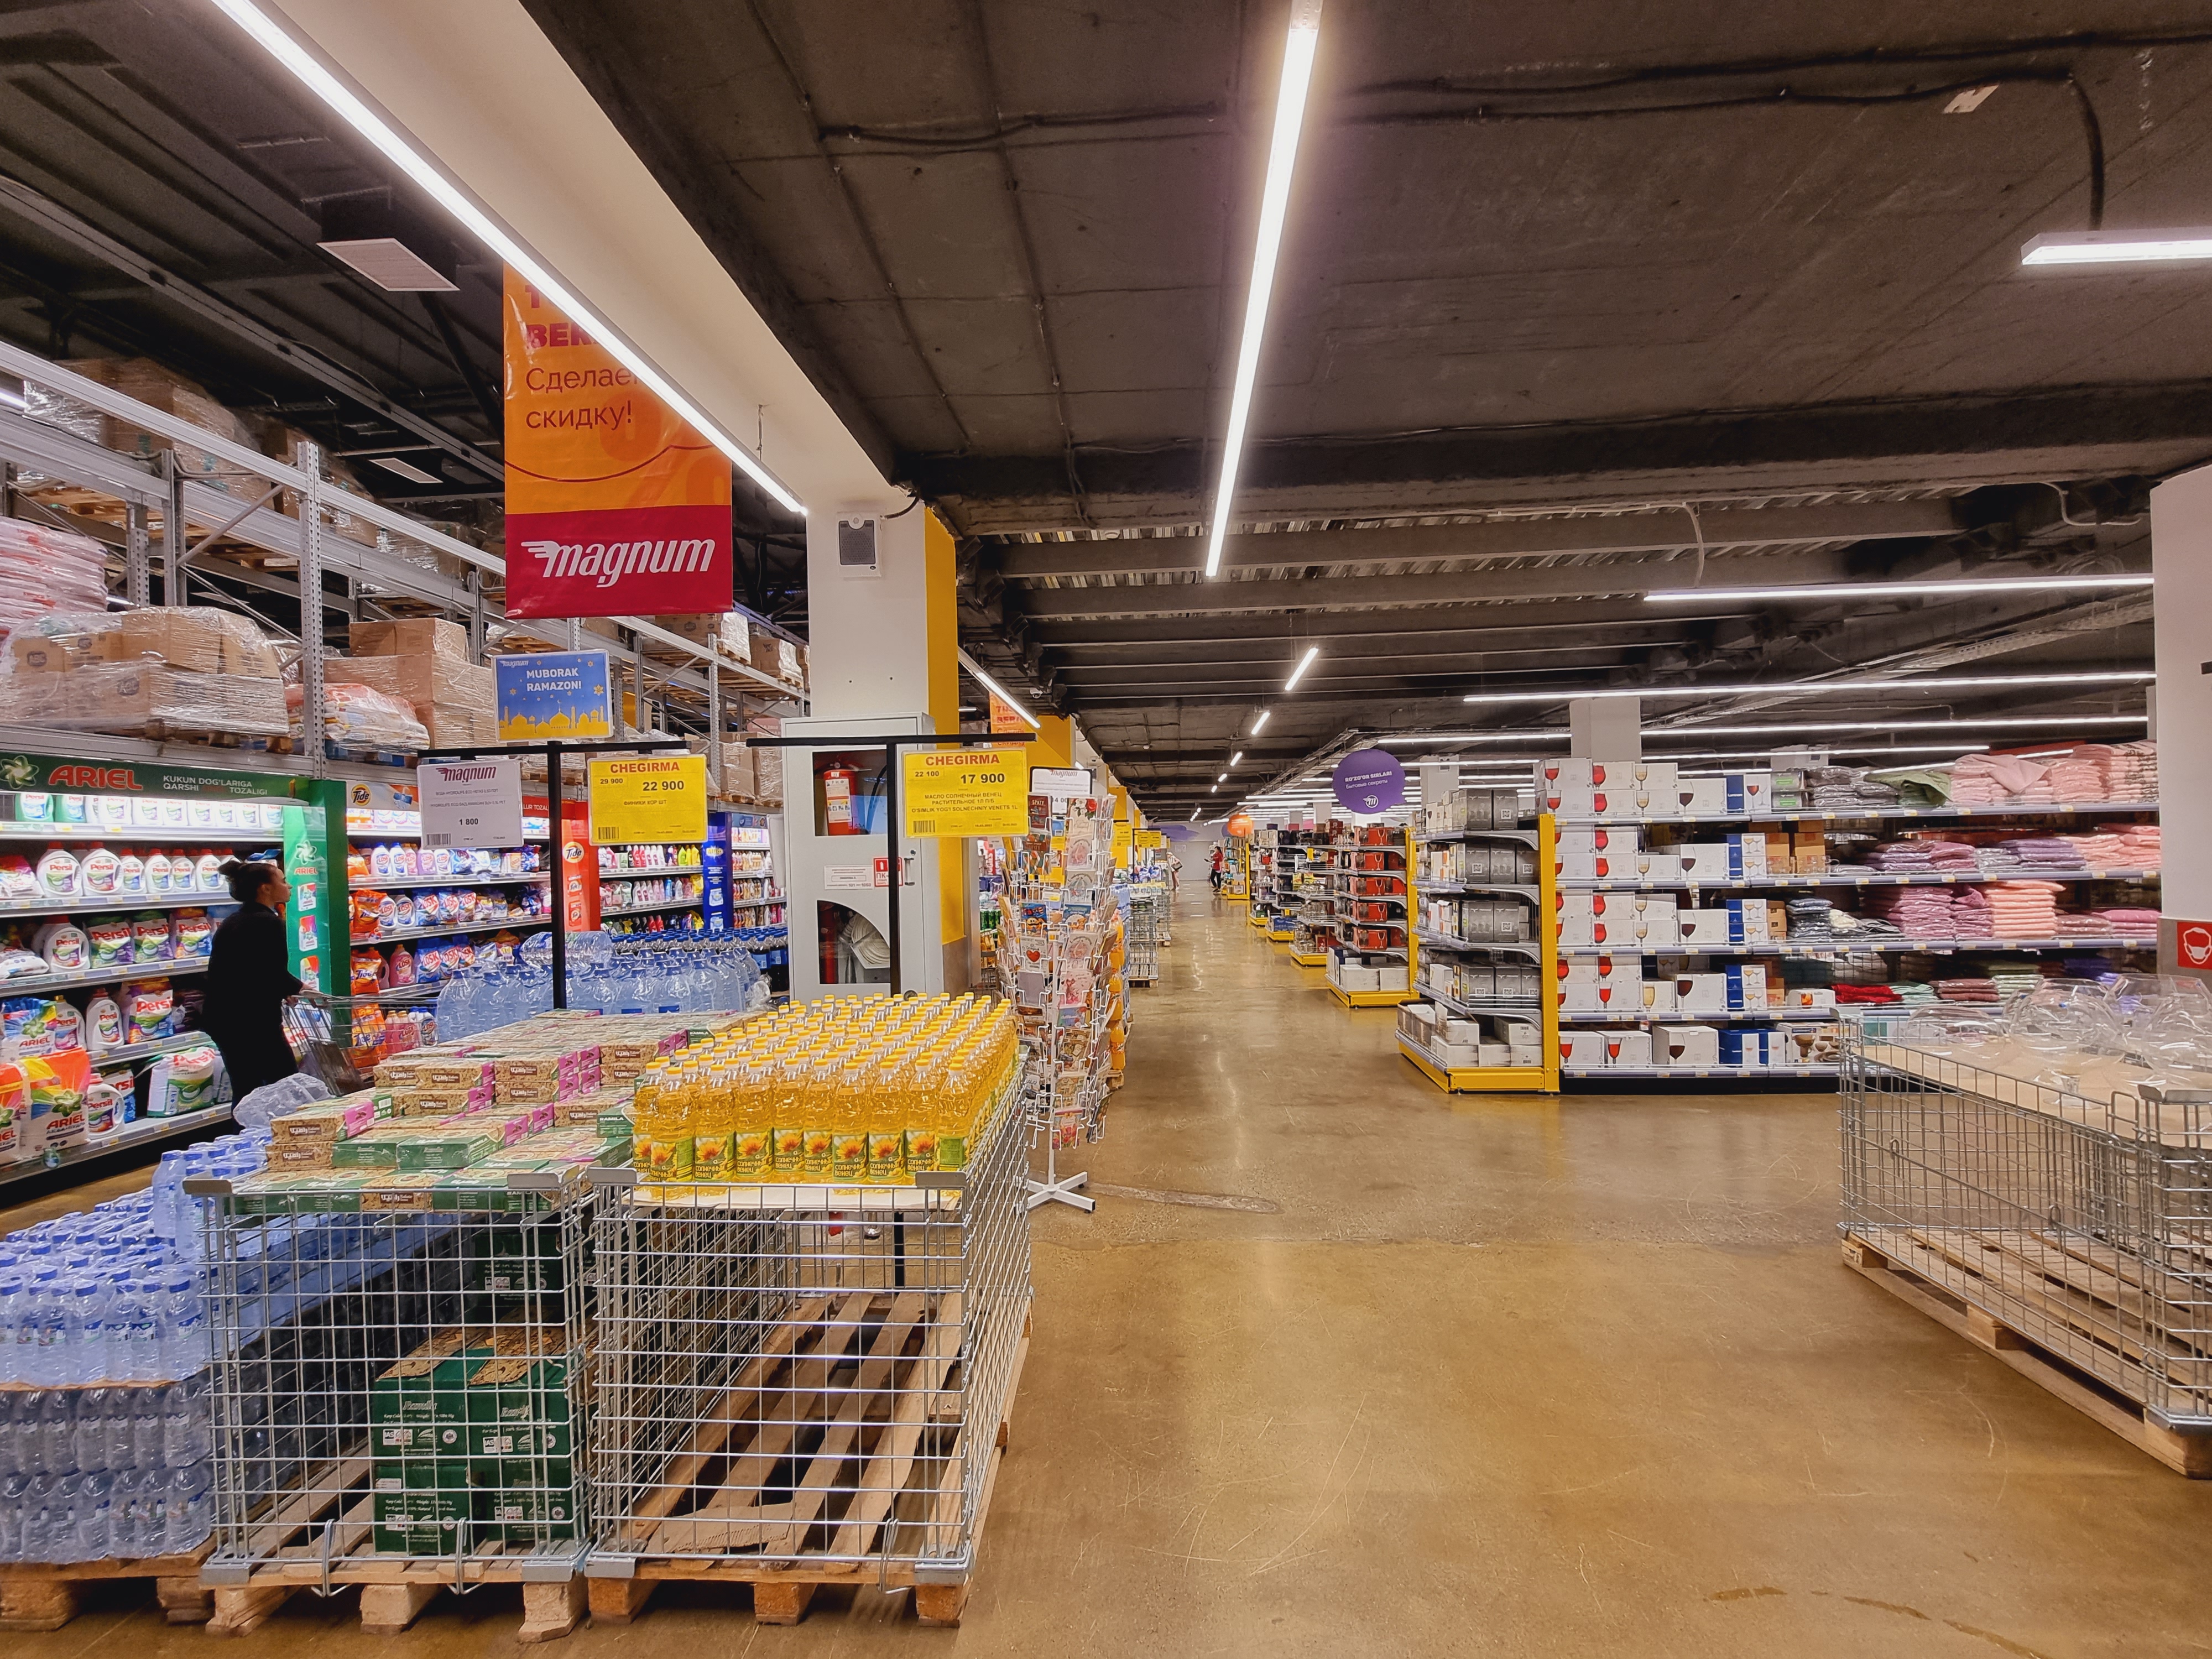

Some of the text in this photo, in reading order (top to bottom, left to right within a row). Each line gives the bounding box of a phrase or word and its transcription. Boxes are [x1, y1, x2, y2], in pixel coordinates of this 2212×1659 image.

[526, 400, 633, 430] скидку!
[521, 539, 716, 587] magnum
[526, 667, 579, 679] MUBORAK
[526, 681, 581, 691] RAMAZON!
[926, 754, 1000, 765] CHEGIRMA
[611, 761, 680, 773] CHEGIRMA
[48, 765, 143, 790] ARIEL
[436, 766, 497, 782] magnum
[961, 773, 1005, 784] 17 900
[1049, 769, 1078, 778] magnum
[163, 775, 253, 787] KUKUN DOG'LARIGA
[163, 782, 199, 791] QARSHI
[643, 781, 684, 791] 22 900
[353, 790, 369, 803] Tide
[566, 848, 582, 859] Tide
[92, 927, 131, 940] Persil
[137, 924, 169, 936] Persil
[179, 922, 211, 933] Persil
[424, 951, 439, 966] LOSK
[136, 997, 173, 1013] Persi
[19, 1036, 50, 1047] ARIEL
[46, 1114, 85, 1129] ARIEL
